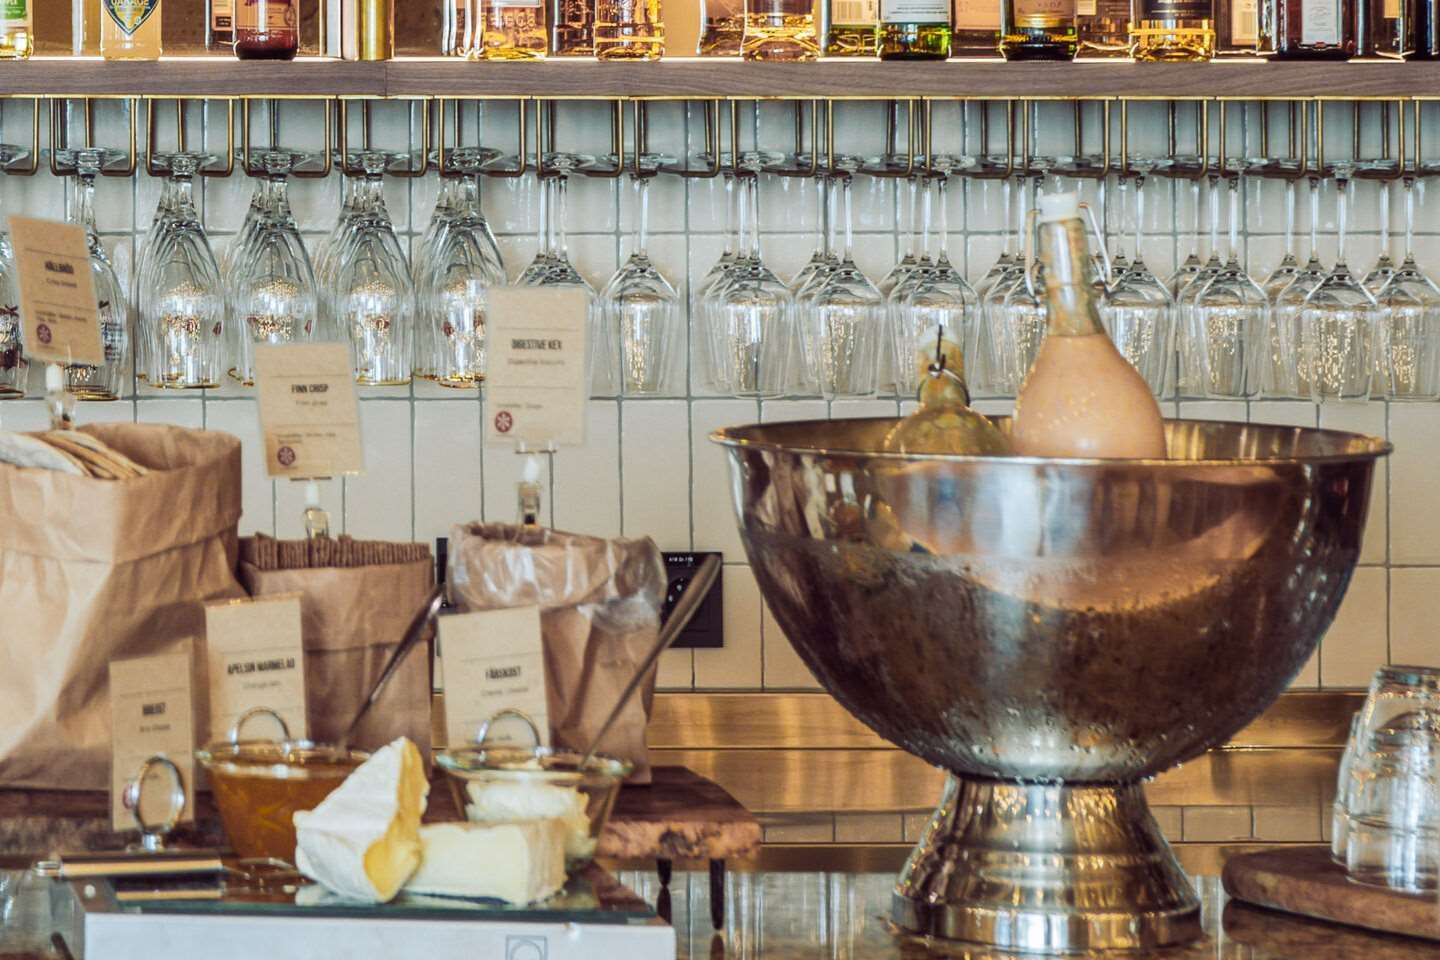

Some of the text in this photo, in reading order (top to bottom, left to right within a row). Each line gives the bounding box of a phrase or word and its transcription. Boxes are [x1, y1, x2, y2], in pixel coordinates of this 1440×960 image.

[291, 383, 329, 393] FINN CRISP
[227, 660, 256, 676] APELSIN
